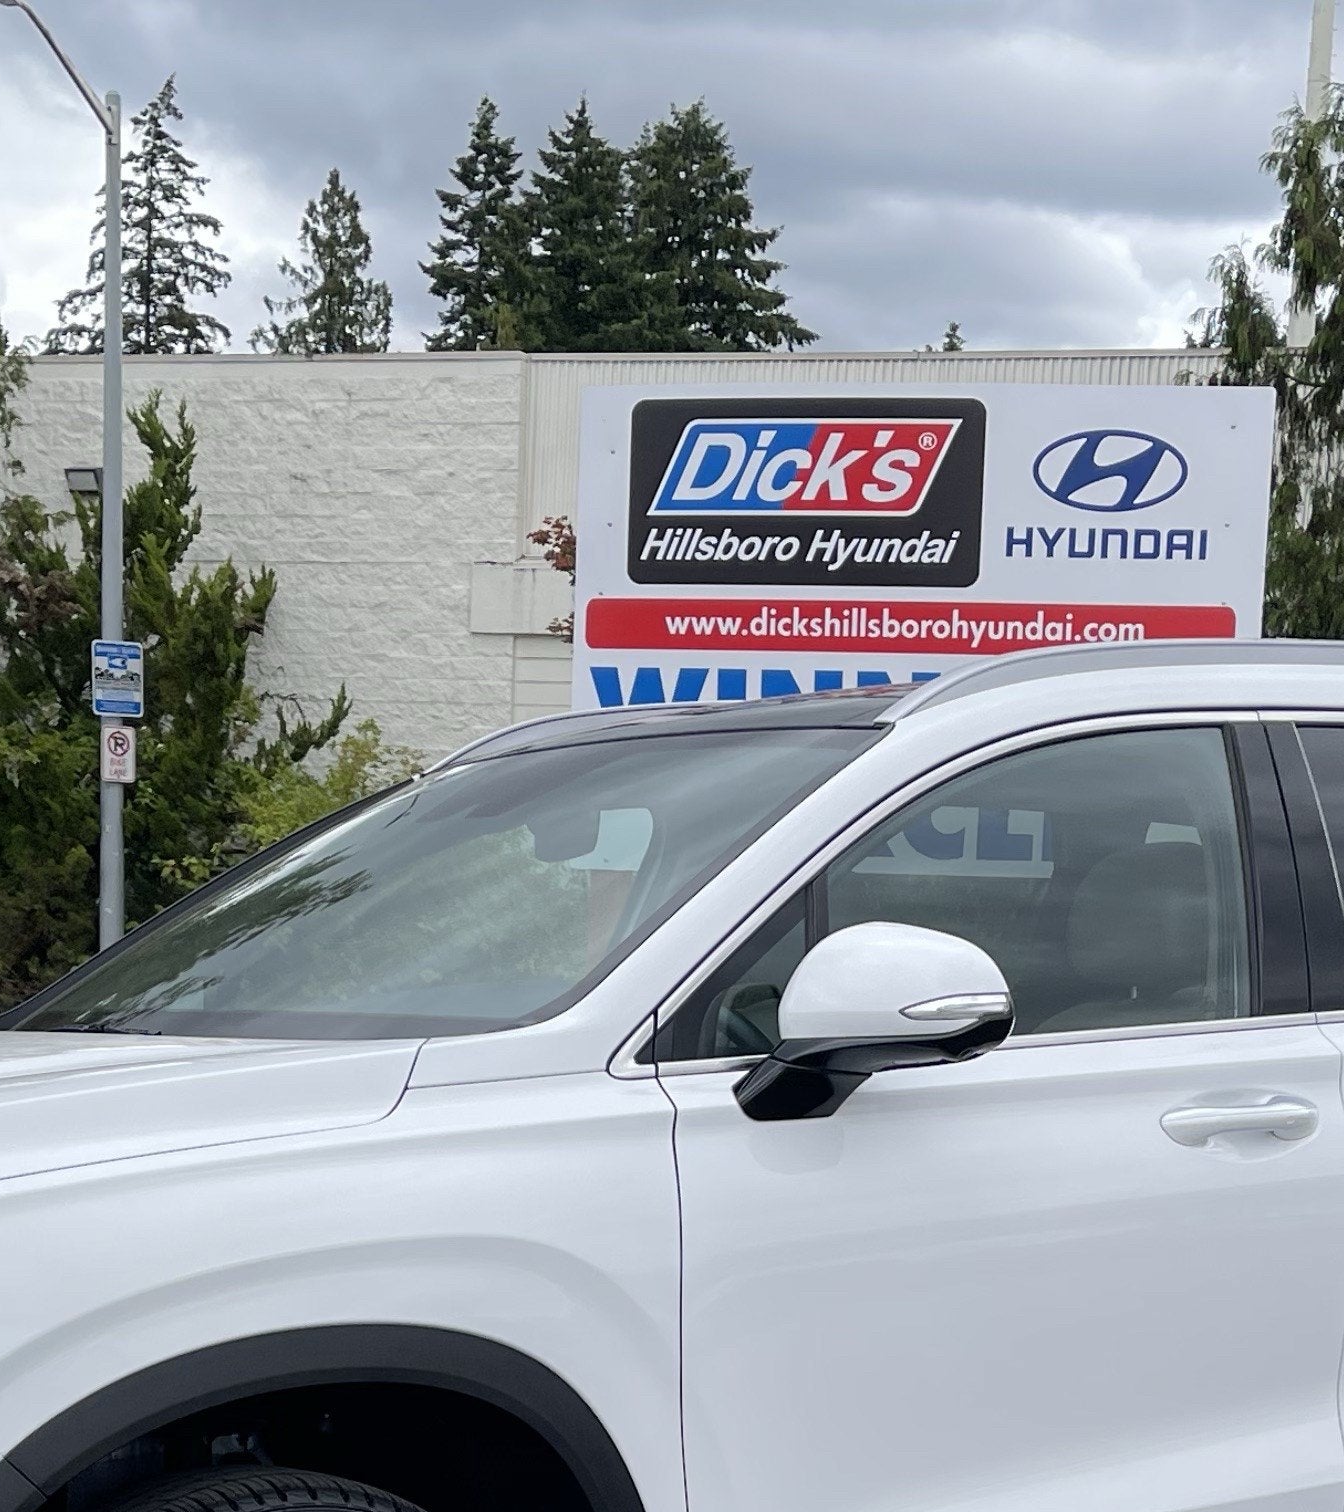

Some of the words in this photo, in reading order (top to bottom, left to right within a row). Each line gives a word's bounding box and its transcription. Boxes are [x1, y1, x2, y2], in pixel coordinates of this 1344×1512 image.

[640, 528, 799, 561] Hillsboro
[806, 530, 960, 571] Hyundai
[1007, 529, 1207, 560] HYUNDAI
[665, 605, 1145, 648] www.dickshillsborohyundai.com
